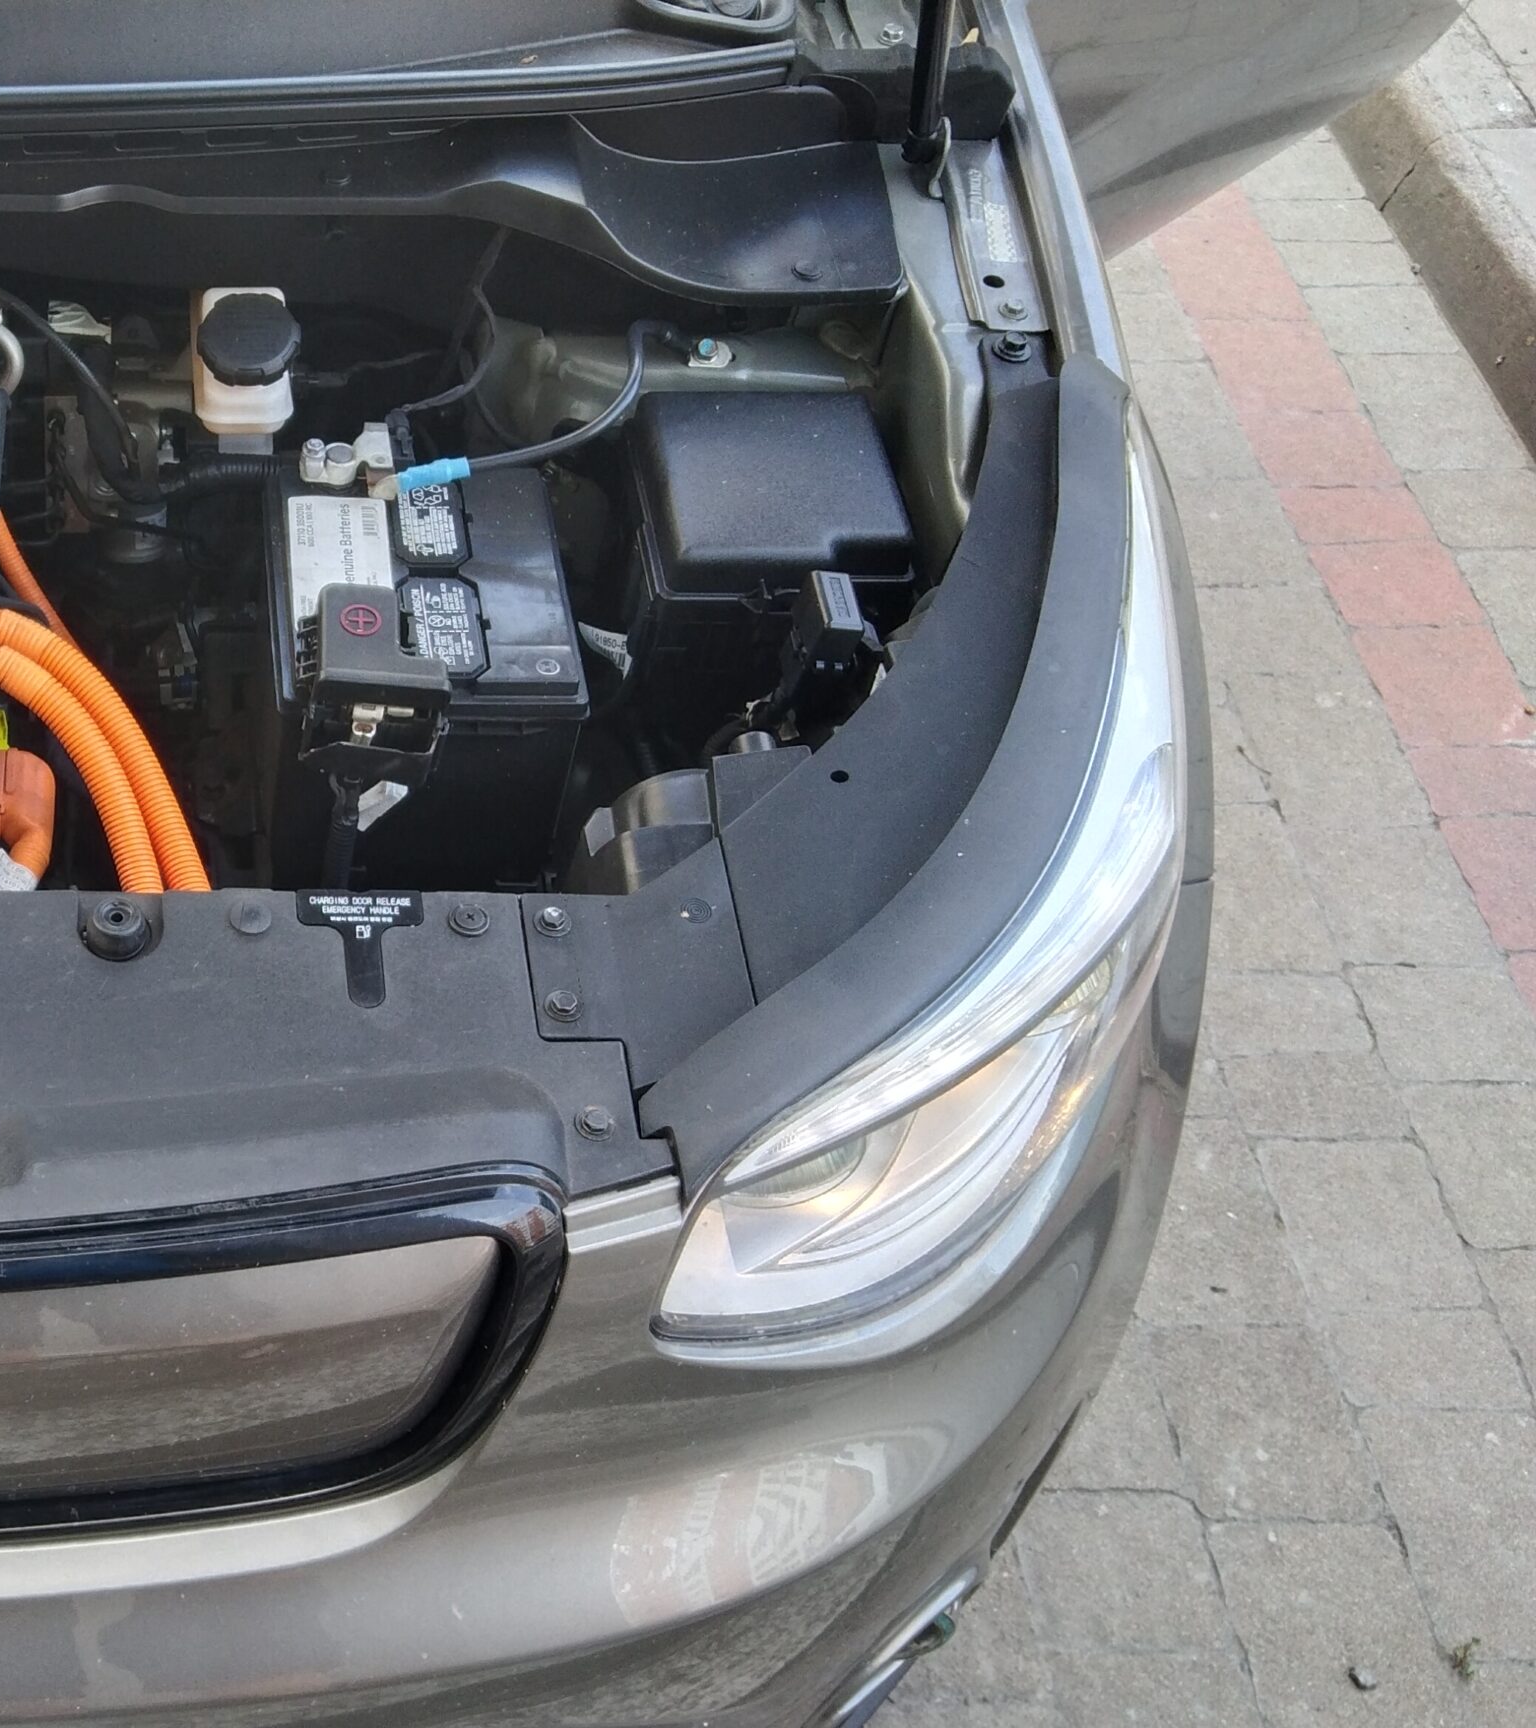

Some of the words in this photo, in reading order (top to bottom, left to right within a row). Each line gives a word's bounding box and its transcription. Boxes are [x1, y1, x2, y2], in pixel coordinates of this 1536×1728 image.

[338, 503, 352, 547] Batteries
[340, 548, 355, 584] enuine
[415, 624, 428, 654] DANGER
[309, 896, 349, 905] CHARGING
[352, 896, 372, 905] DOOR
[376, 897, 411, 906] RELEASE
[322, 906, 365, 914] EMERGENCY
[369, 906, 400, 915] HANDLE
